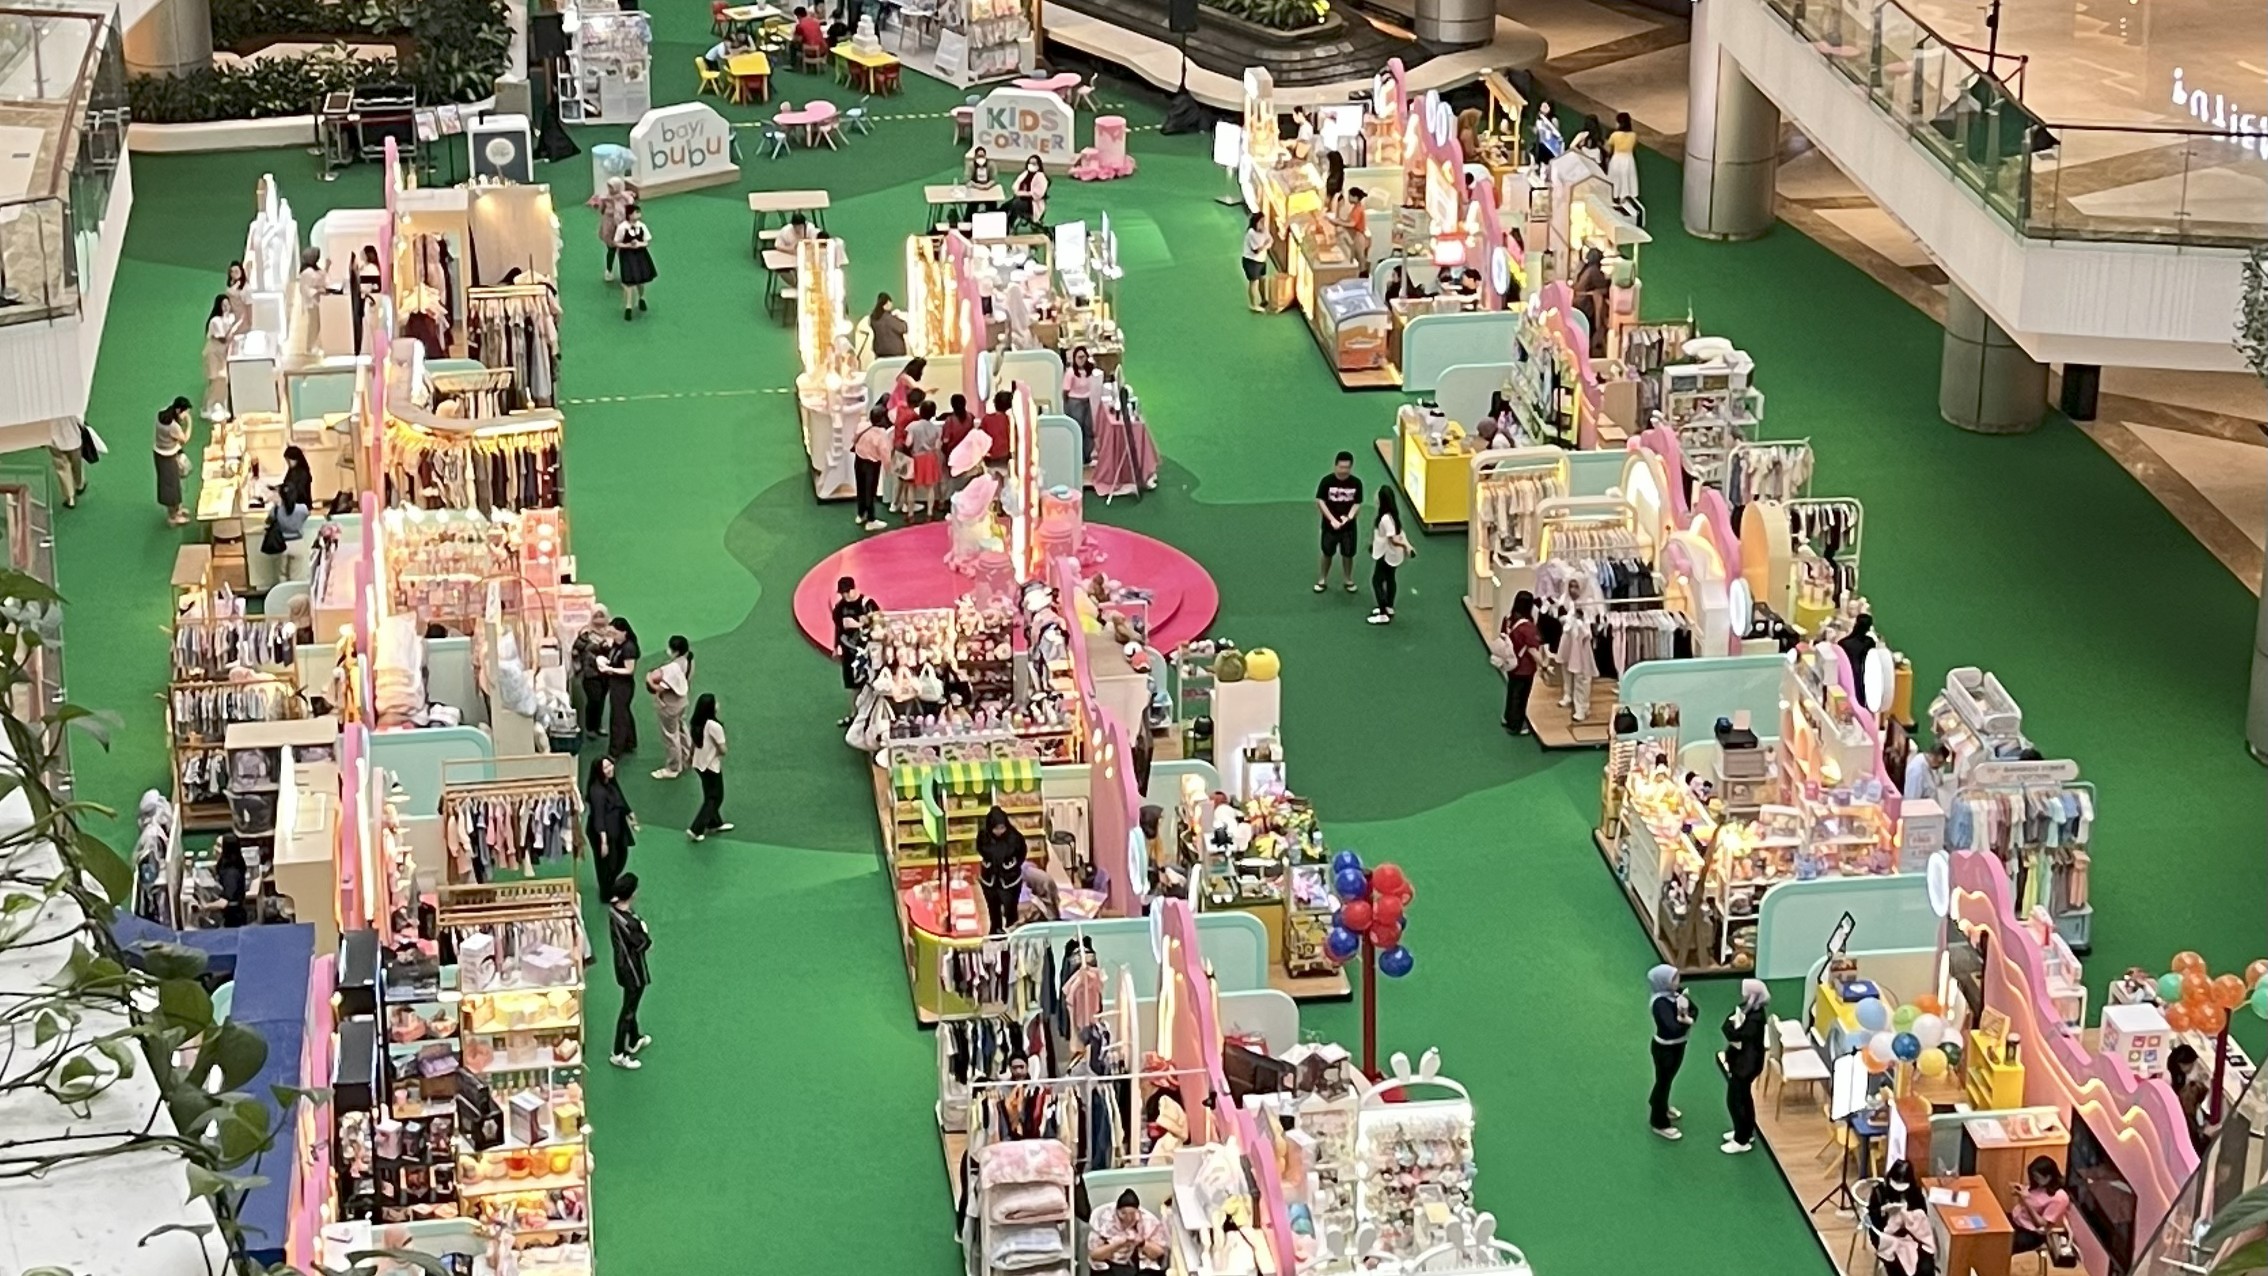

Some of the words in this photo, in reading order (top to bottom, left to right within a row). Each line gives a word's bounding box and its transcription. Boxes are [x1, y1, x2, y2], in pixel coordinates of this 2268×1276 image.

[661, 119, 704, 142] bayi
[986, 106, 1059, 132] KIDS
[648, 136, 721, 171] bubu
[978, 130, 1065, 154] CORNER
